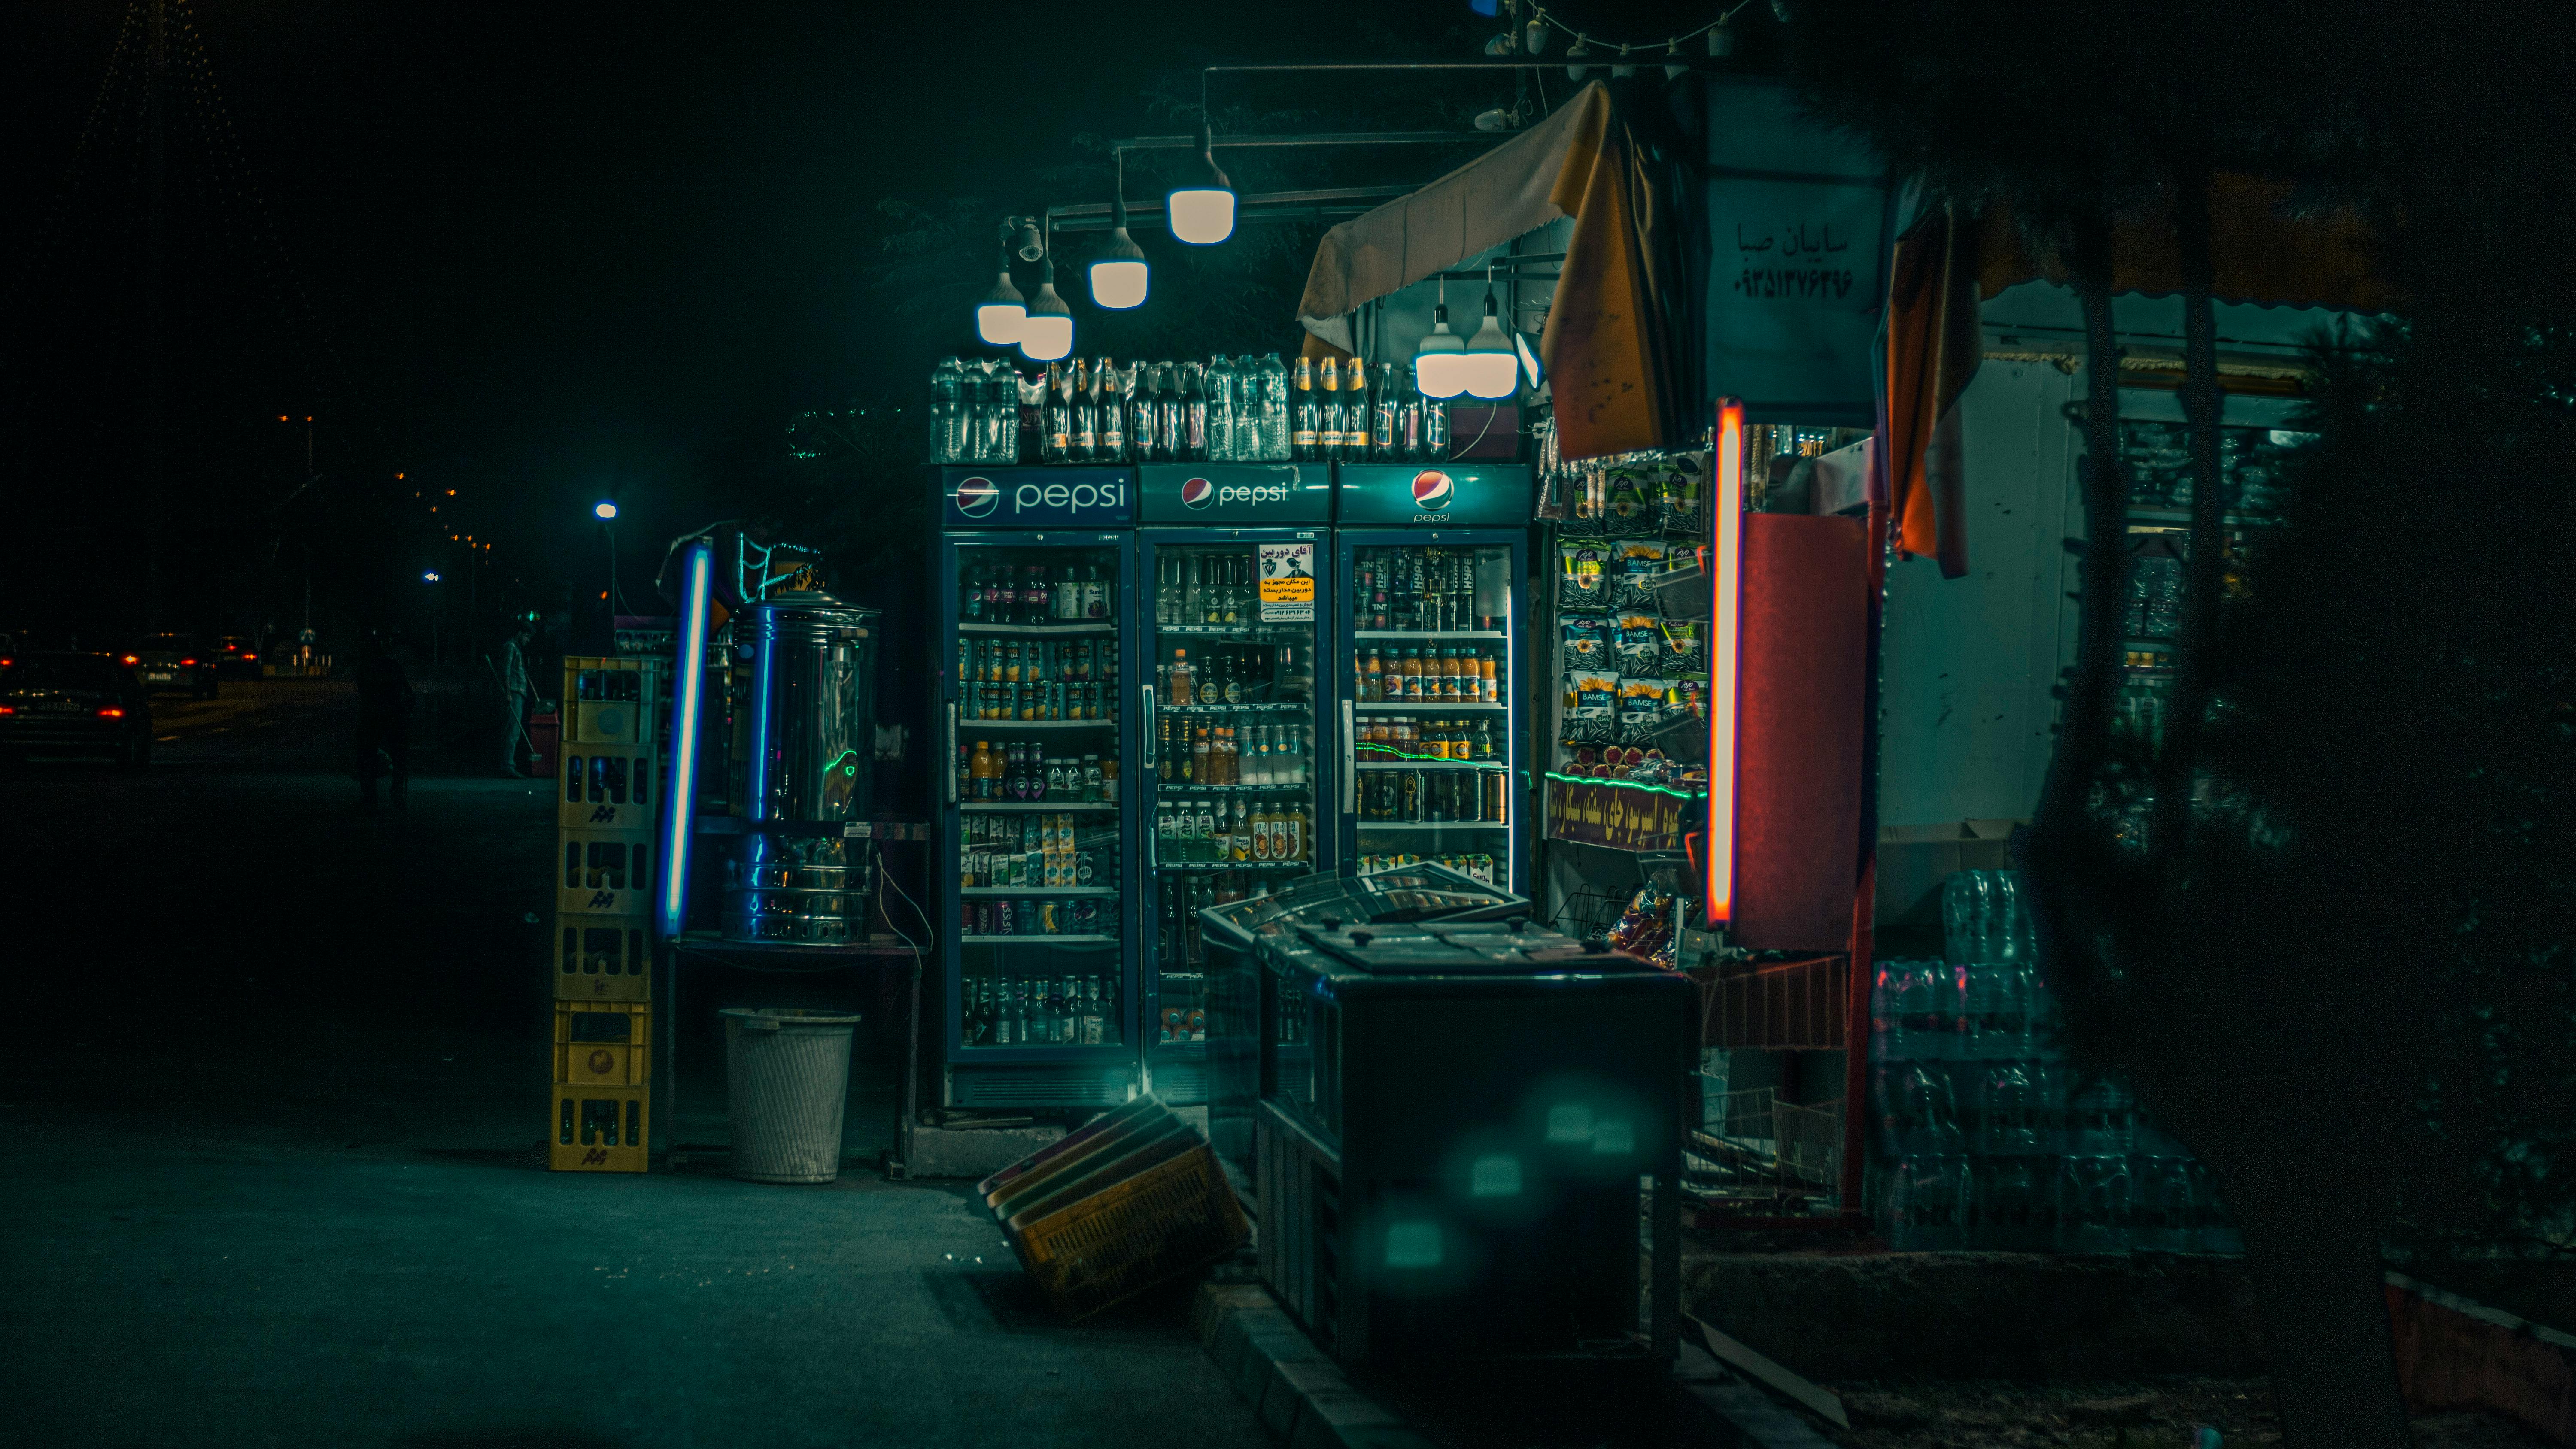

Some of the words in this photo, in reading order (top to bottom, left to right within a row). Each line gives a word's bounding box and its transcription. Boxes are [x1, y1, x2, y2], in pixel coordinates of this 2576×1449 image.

[1738, 224, 1773, 262] صبا
[1015, 478, 1124, 514] pepsi
[1219, 482, 1287, 506] pepsi
[1413, 513, 1450, 522] pepsi
[1261, 548, 1289, 558] دوربین
[1292, 545, 1312, 558] آقای
[1414, 558, 1422, 589] HYPE
[1463, 558, 1472, 589] HYPE
